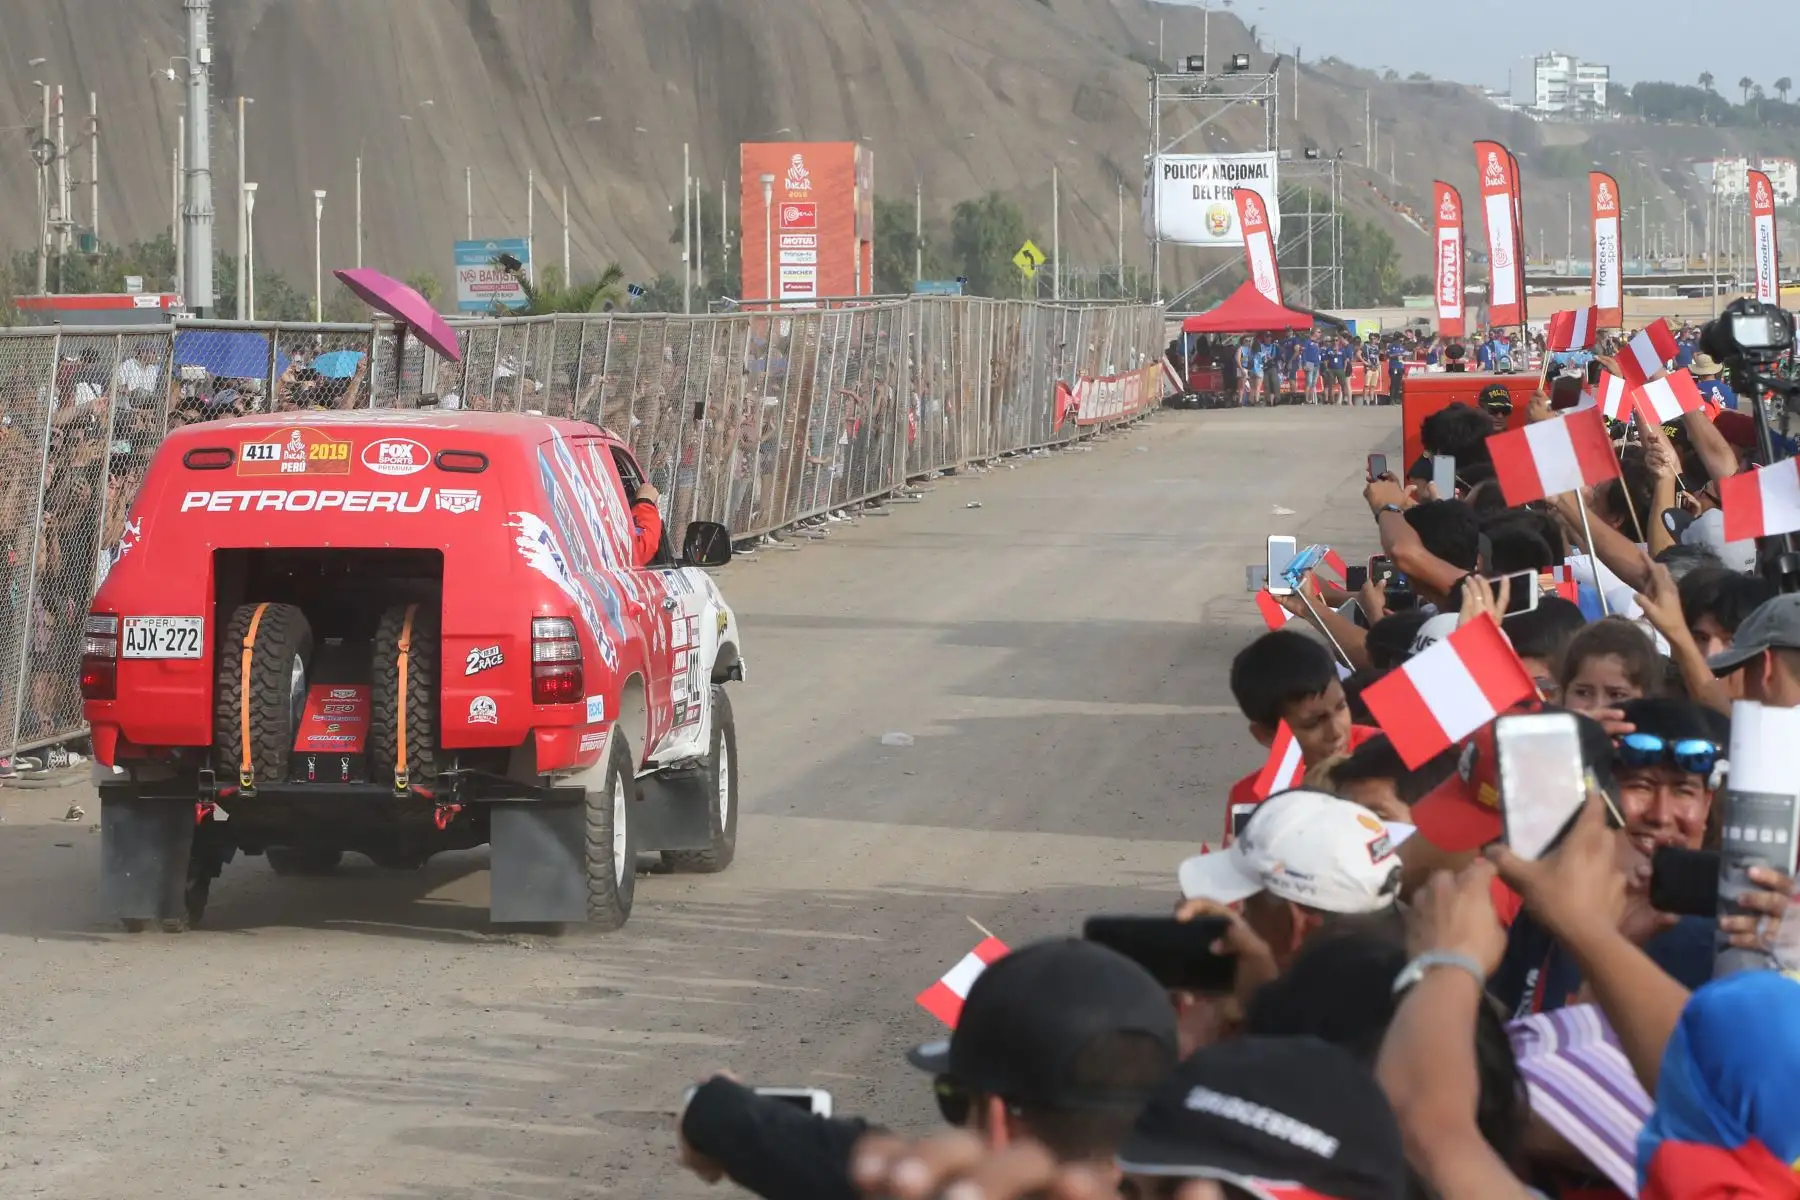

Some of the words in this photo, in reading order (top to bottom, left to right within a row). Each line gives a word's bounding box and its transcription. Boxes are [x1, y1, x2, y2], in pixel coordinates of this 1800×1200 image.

[1211, 163, 1269, 181] NACIONAL
[784, 179, 813, 190] DAKAR
[1192, 185, 1212, 200] DEL
[1214, 183, 1241, 200] PER
[783, 237, 814, 245] MOTUL
[1760, 224, 1769, 298] BFGoodrich
[1443, 243, 1456, 303] MOTUL
[246, 445, 274, 460] 411
[309, 444, 348, 460] 2019
[379, 443, 414, 457] FOX
[378, 456, 414, 465] SPORTS
[126, 628, 198, 651] AJX-272
[465, 653, 481, 675] 2
[479, 653, 503, 670] RACE
